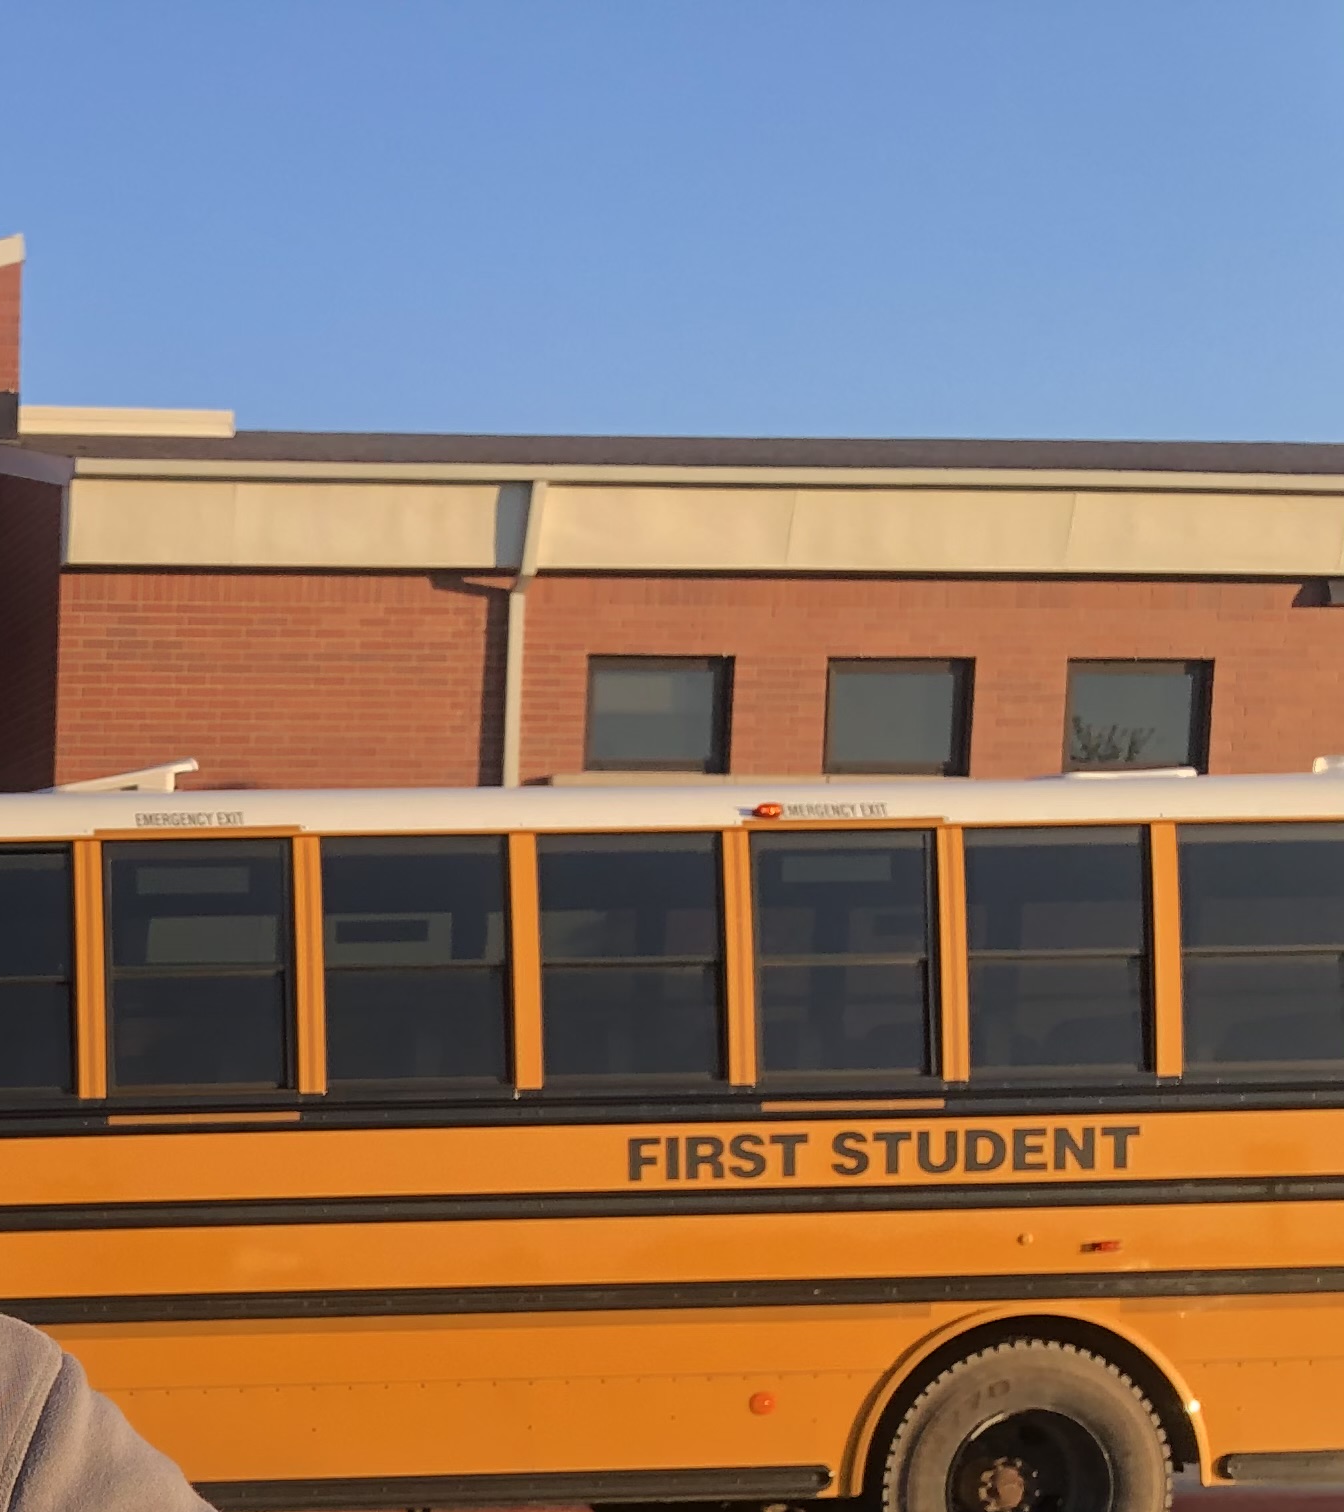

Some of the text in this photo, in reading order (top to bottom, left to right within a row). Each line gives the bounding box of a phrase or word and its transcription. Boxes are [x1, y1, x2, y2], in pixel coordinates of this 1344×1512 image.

[135, 810, 244, 827] EMERGENCY EXIT
[782, 802, 888, 818] MERGENCY EXIT
[628, 1125, 1141, 1182] FIRST STUDENT
